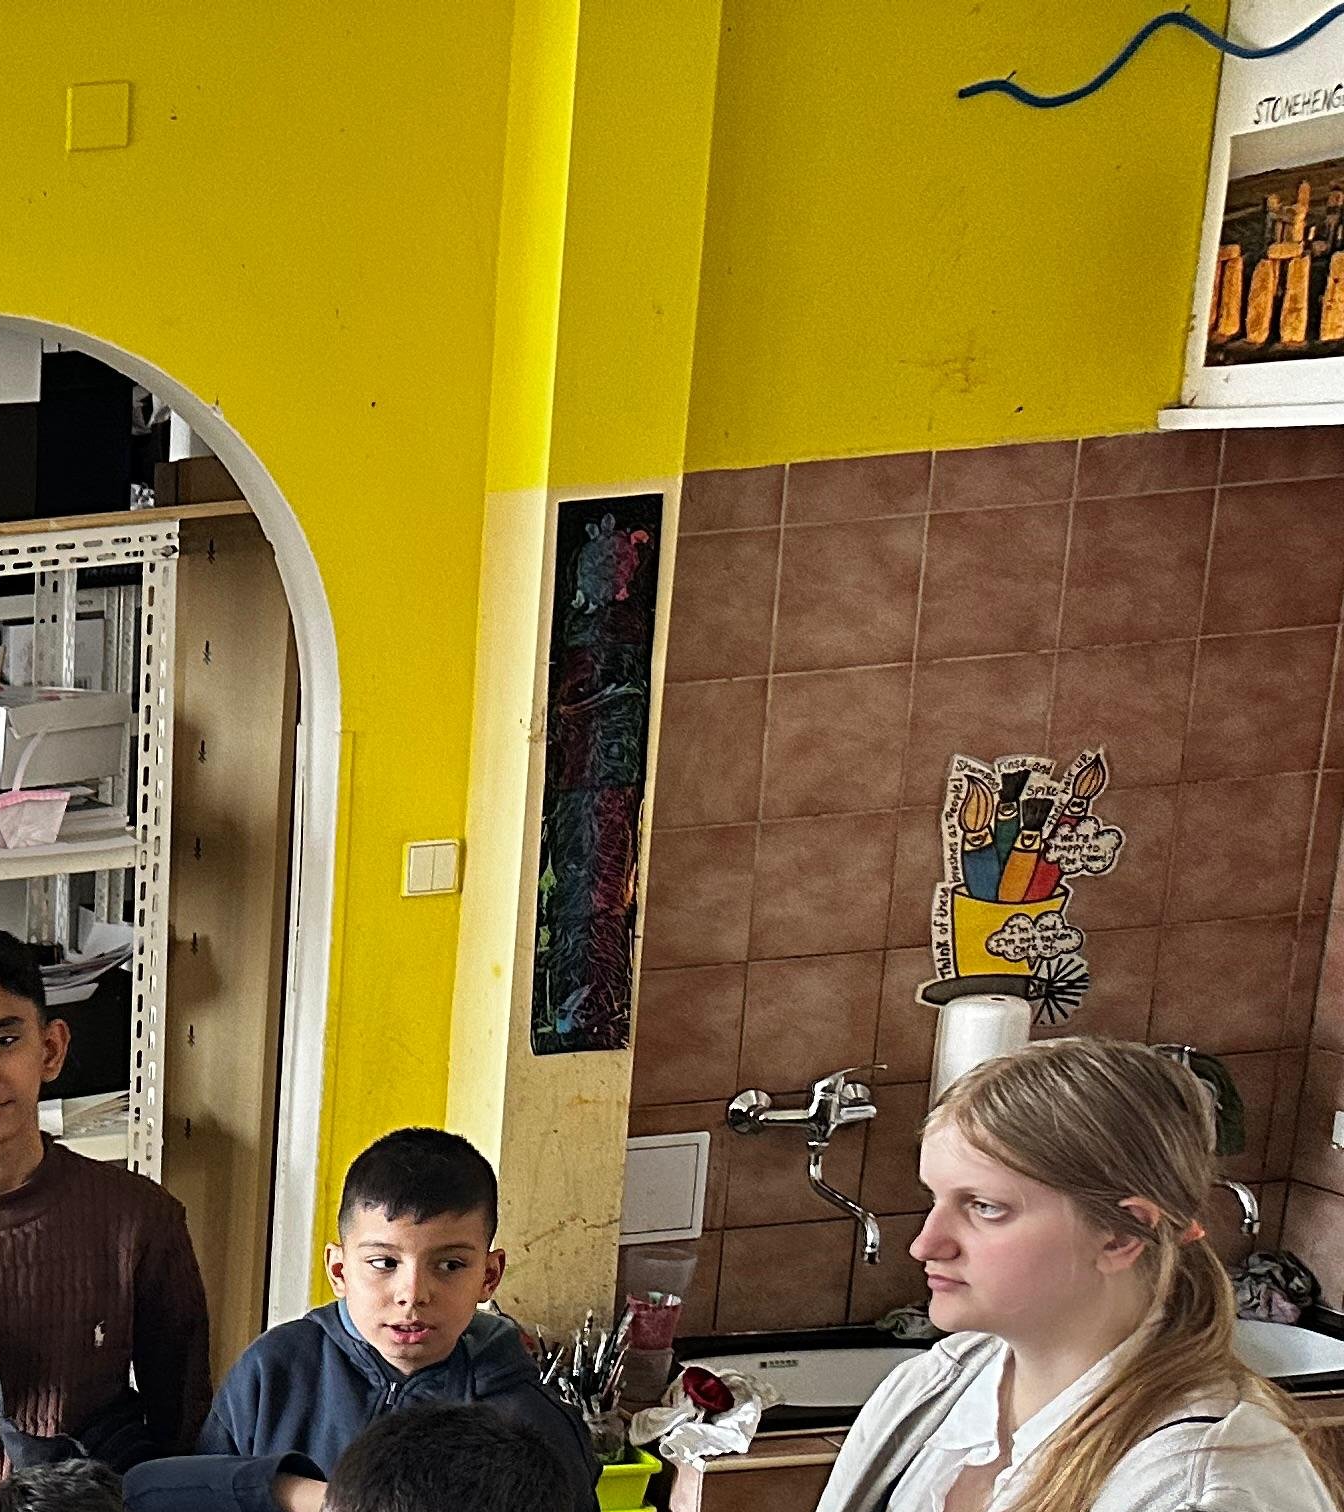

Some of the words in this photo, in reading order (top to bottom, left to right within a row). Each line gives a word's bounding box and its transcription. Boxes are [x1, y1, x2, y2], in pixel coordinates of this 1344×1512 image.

[1253, 83, 1344, 125] STONEHENG
[948, 823, 958, 839] as
[937, 886, 951, 918] these
[933, 919, 949, 936] of
[935, 939, 952, 979] Think
